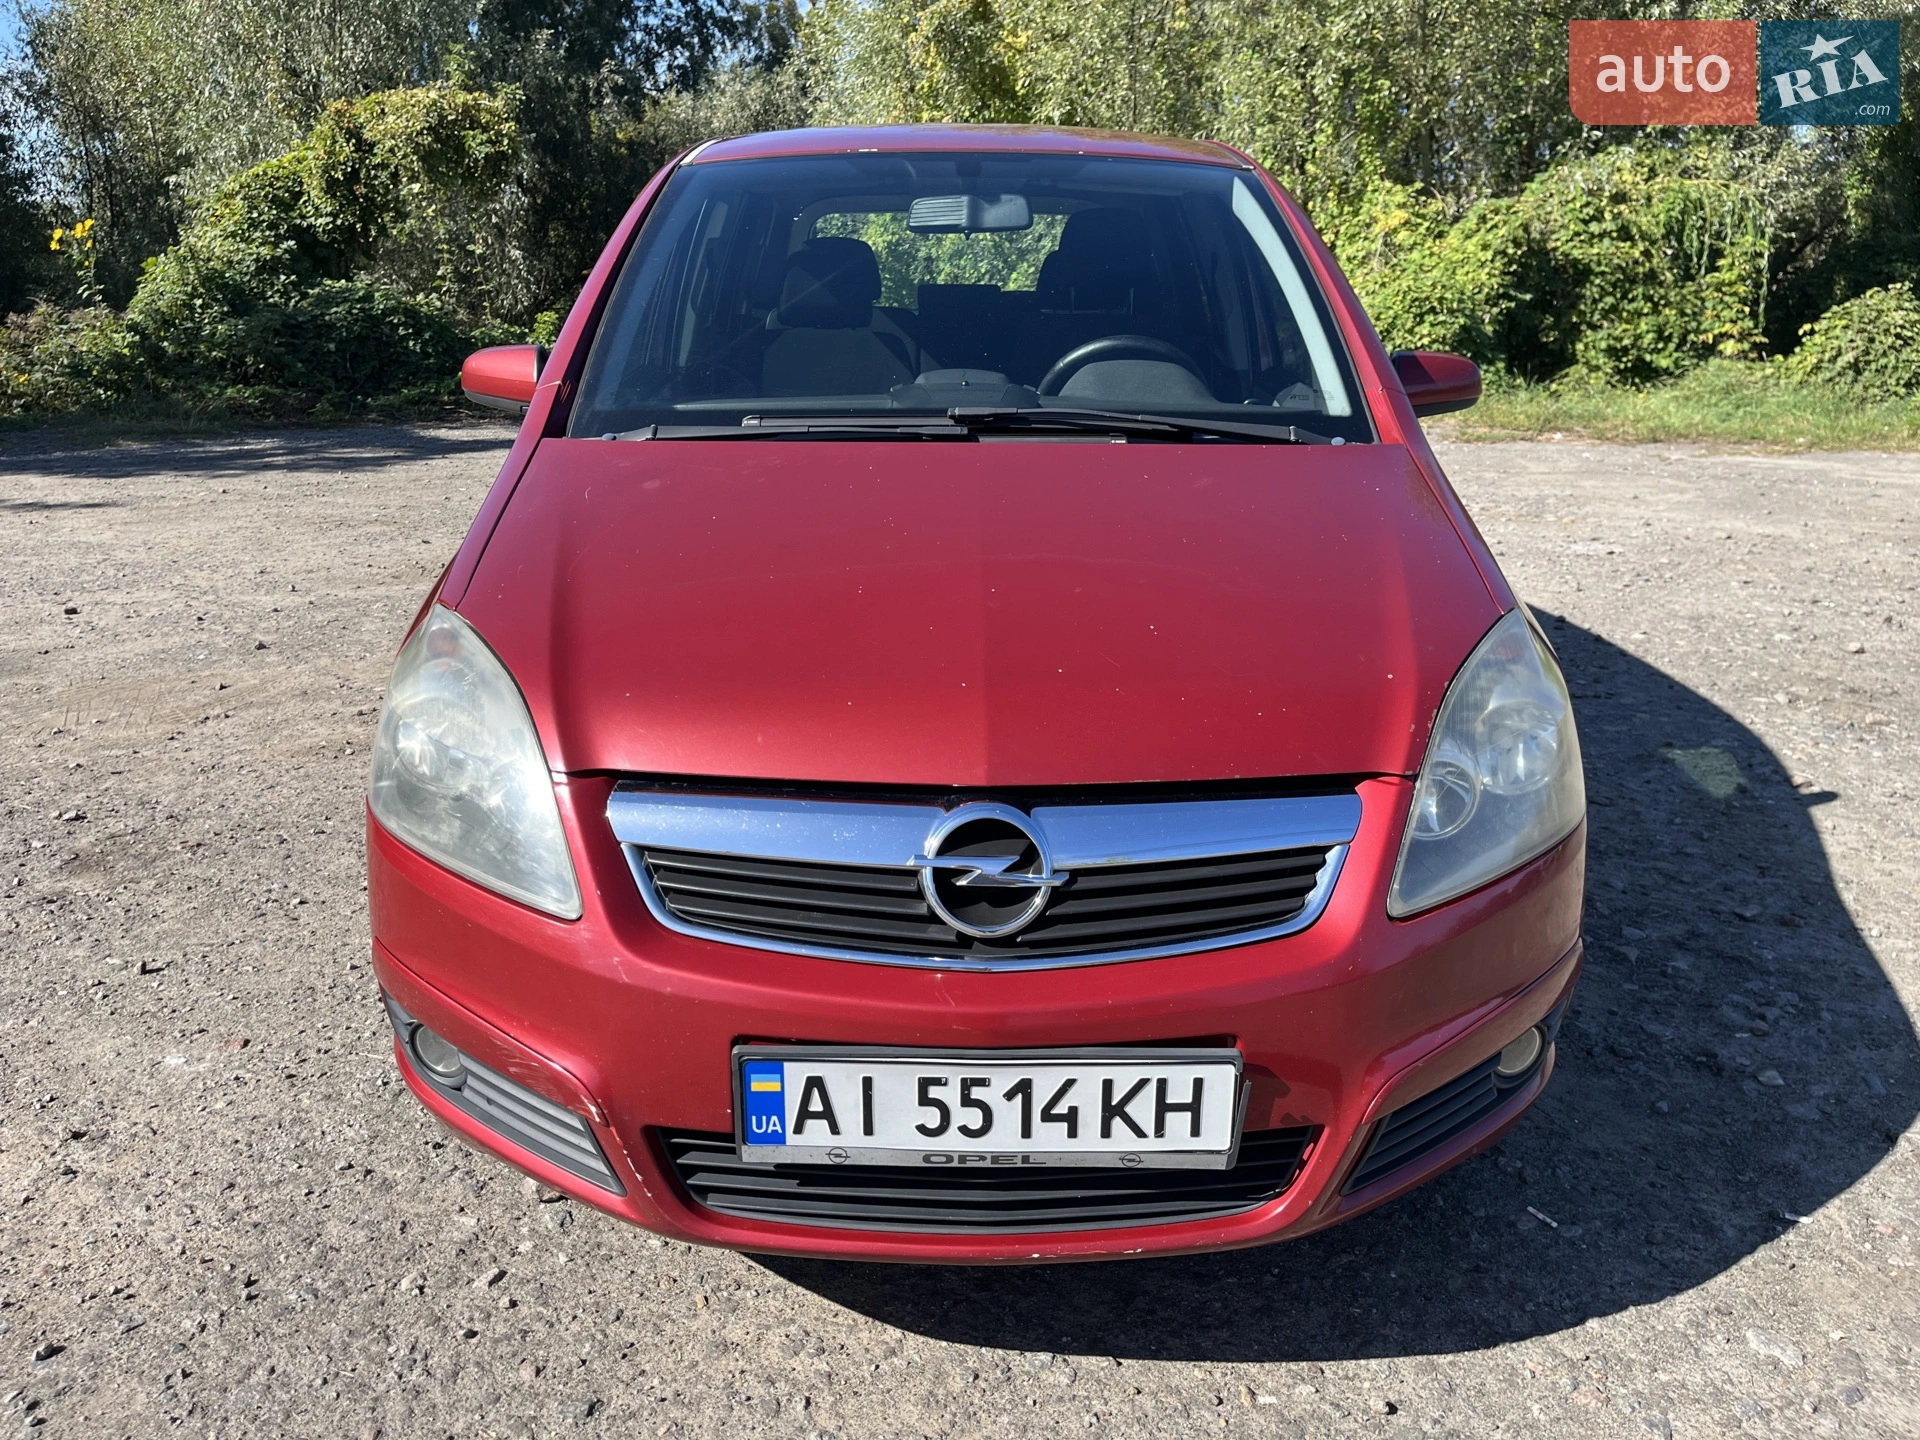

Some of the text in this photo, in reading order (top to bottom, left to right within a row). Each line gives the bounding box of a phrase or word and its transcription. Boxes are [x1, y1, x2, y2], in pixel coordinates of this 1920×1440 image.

[792, 1075, 1203, 1139] AI 5514 KH
[752, 1115, 783, 1134] UA
[921, 1153, 1047, 1166] OPEL
